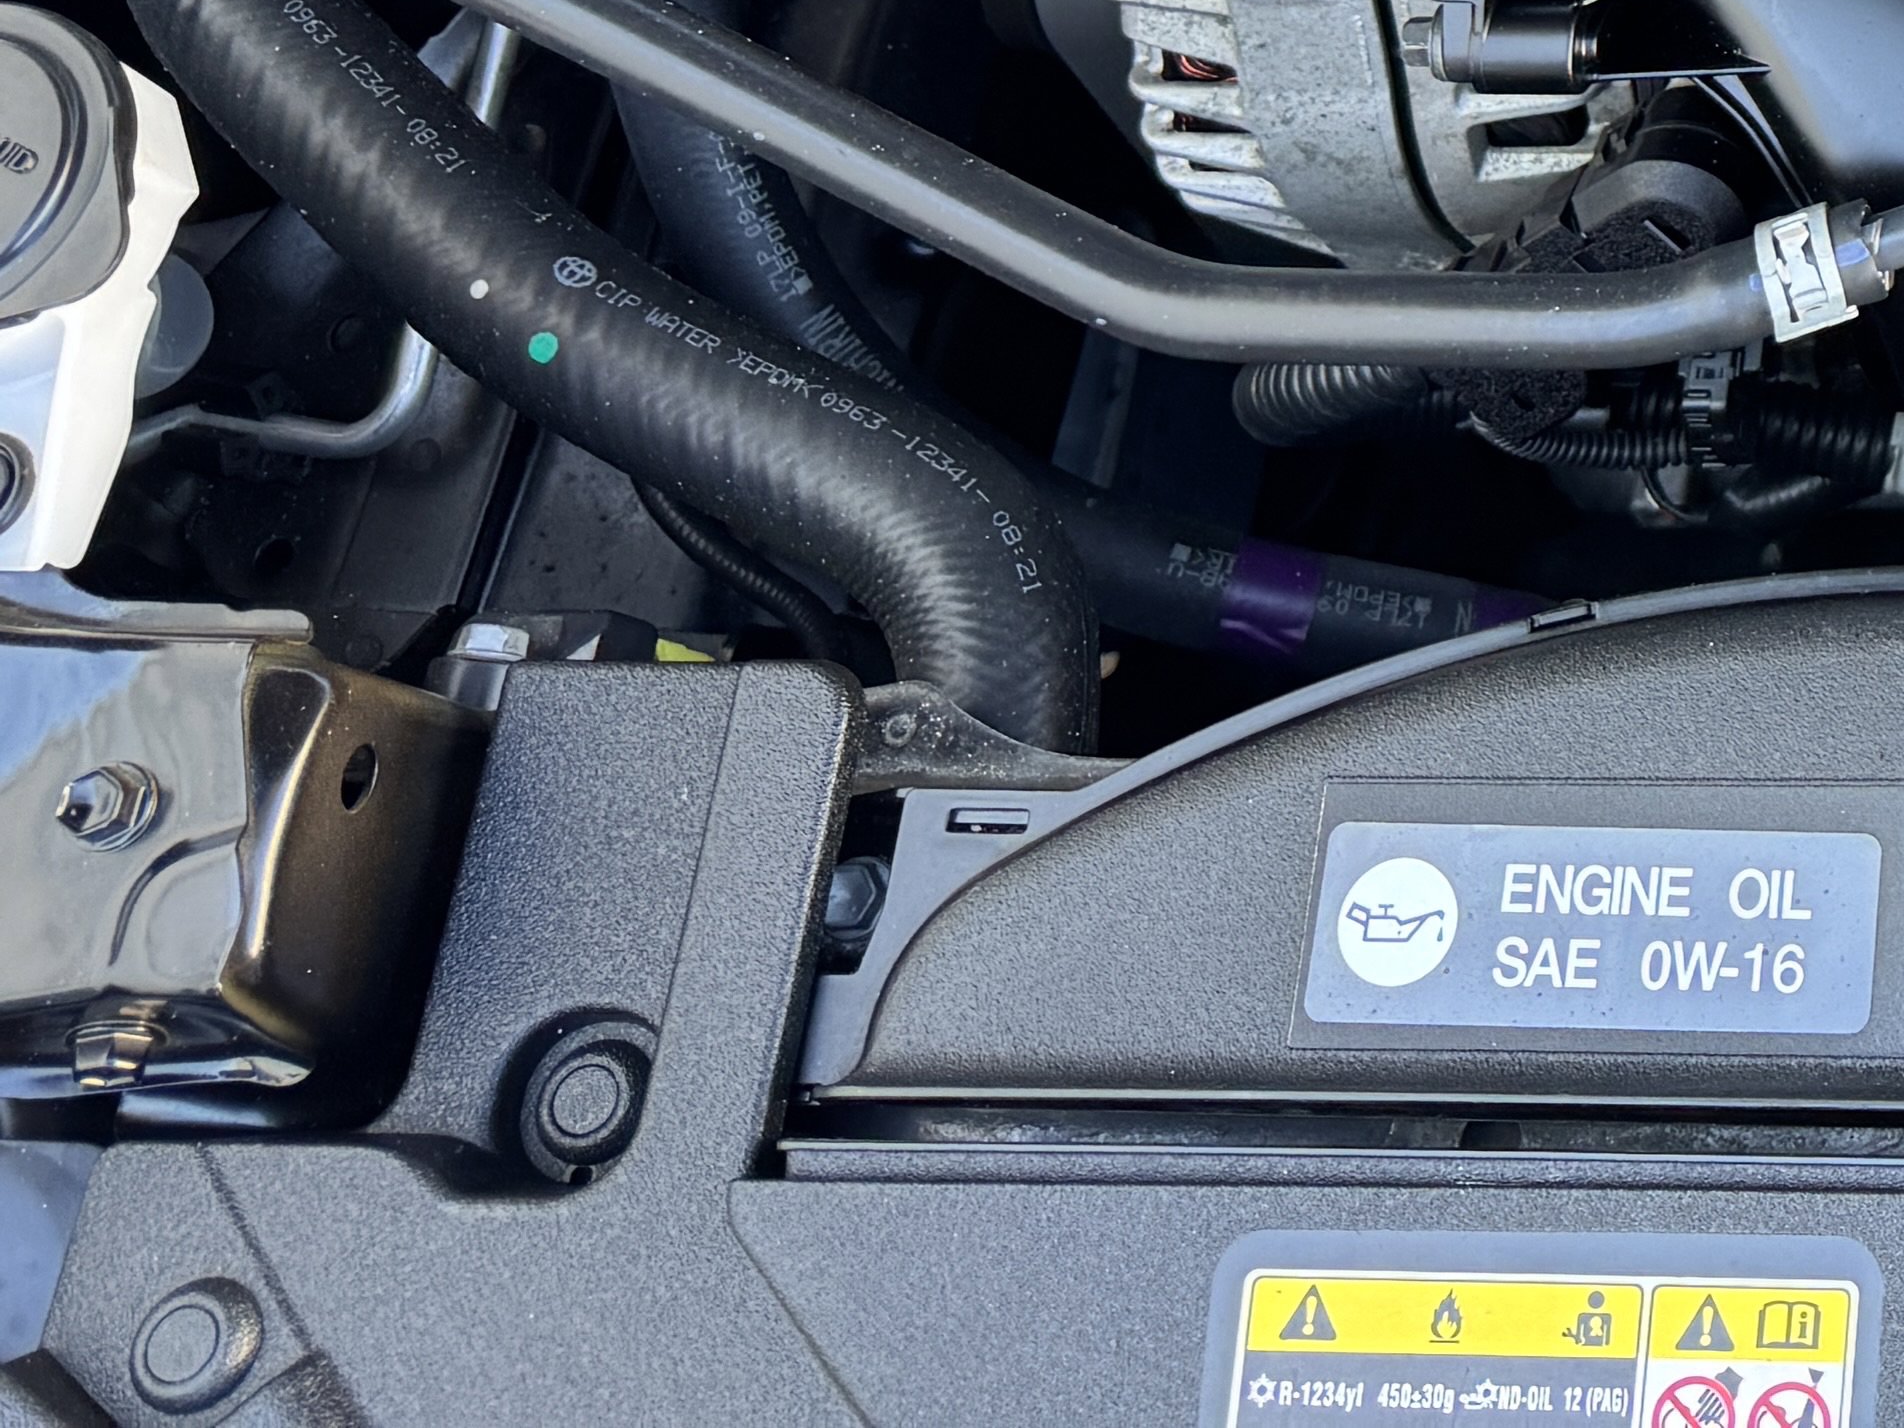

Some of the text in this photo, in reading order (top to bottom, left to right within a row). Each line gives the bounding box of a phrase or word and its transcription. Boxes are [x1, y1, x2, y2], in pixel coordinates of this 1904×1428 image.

[284, 0, 338, 44] 0963
[644, 306, 722, 354] WATER
[820, 391, 888, 430] 0963
[992, 510, 1042, 594] 08:21
[1500, 863, 1813, 920] ENGINE OIL
[1492, 937, 1806, 993] SAE 0W-16
[1377, 1383, 1455, 1414] 450±30g
[1499, 1386, 1553, 1412] ND-OIL
[1564, 1387, 1582, 1412] 12
[1586, 1386, 1629, 1417] (PAG)
